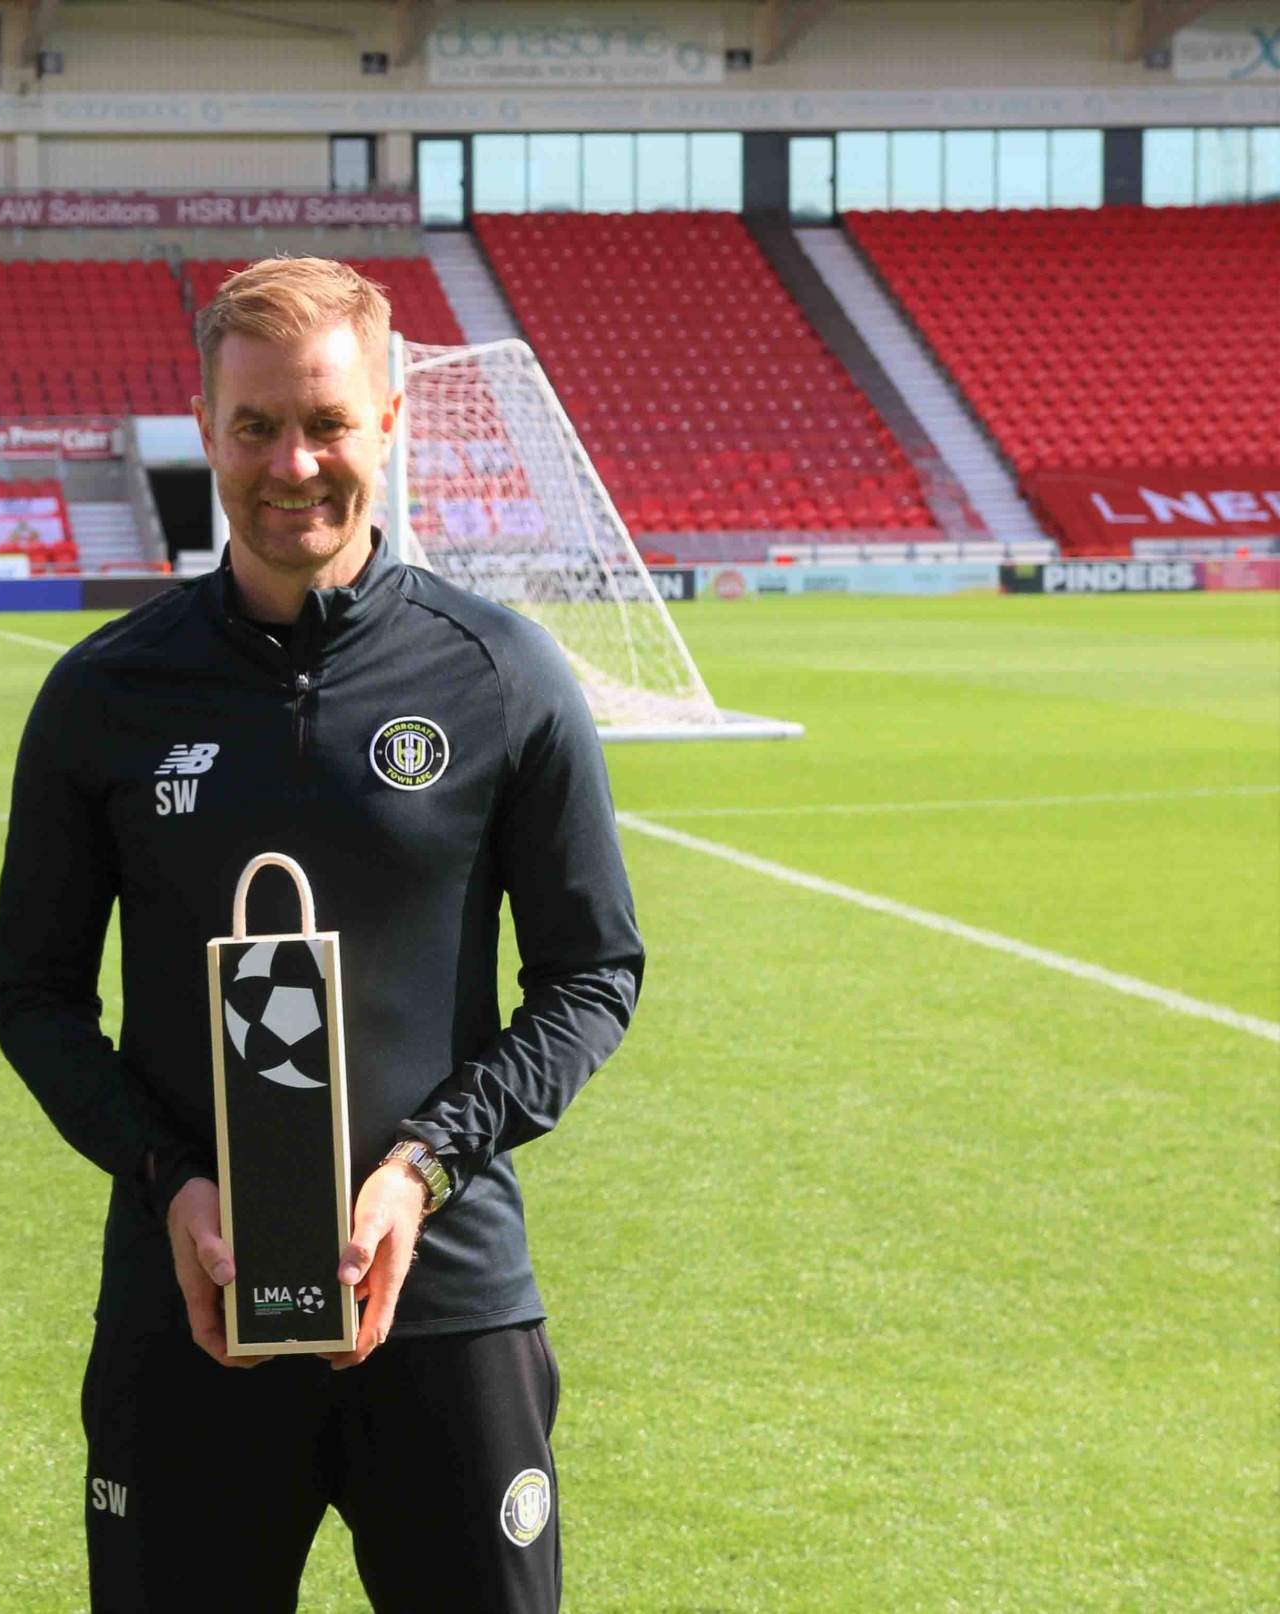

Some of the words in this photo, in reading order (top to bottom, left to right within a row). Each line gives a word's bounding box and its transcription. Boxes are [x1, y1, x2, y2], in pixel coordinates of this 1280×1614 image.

[48, 199, 160, 224] Solicitors
[176, 198, 236, 223] HSR
[240, 199, 300, 223] LAW
[305, 197, 414, 223] Solicitors
[1042, 562, 1196, 592] PINDERS
[383, 723, 436, 740] HARROGATE
[386, 767, 413, 785] TOWN
[415, 771, 433, 785] AFC
[154, 778, 199, 816] SW
[253, 1286, 293, 1304] LMA
[91, 1477, 128, 1518] SW
